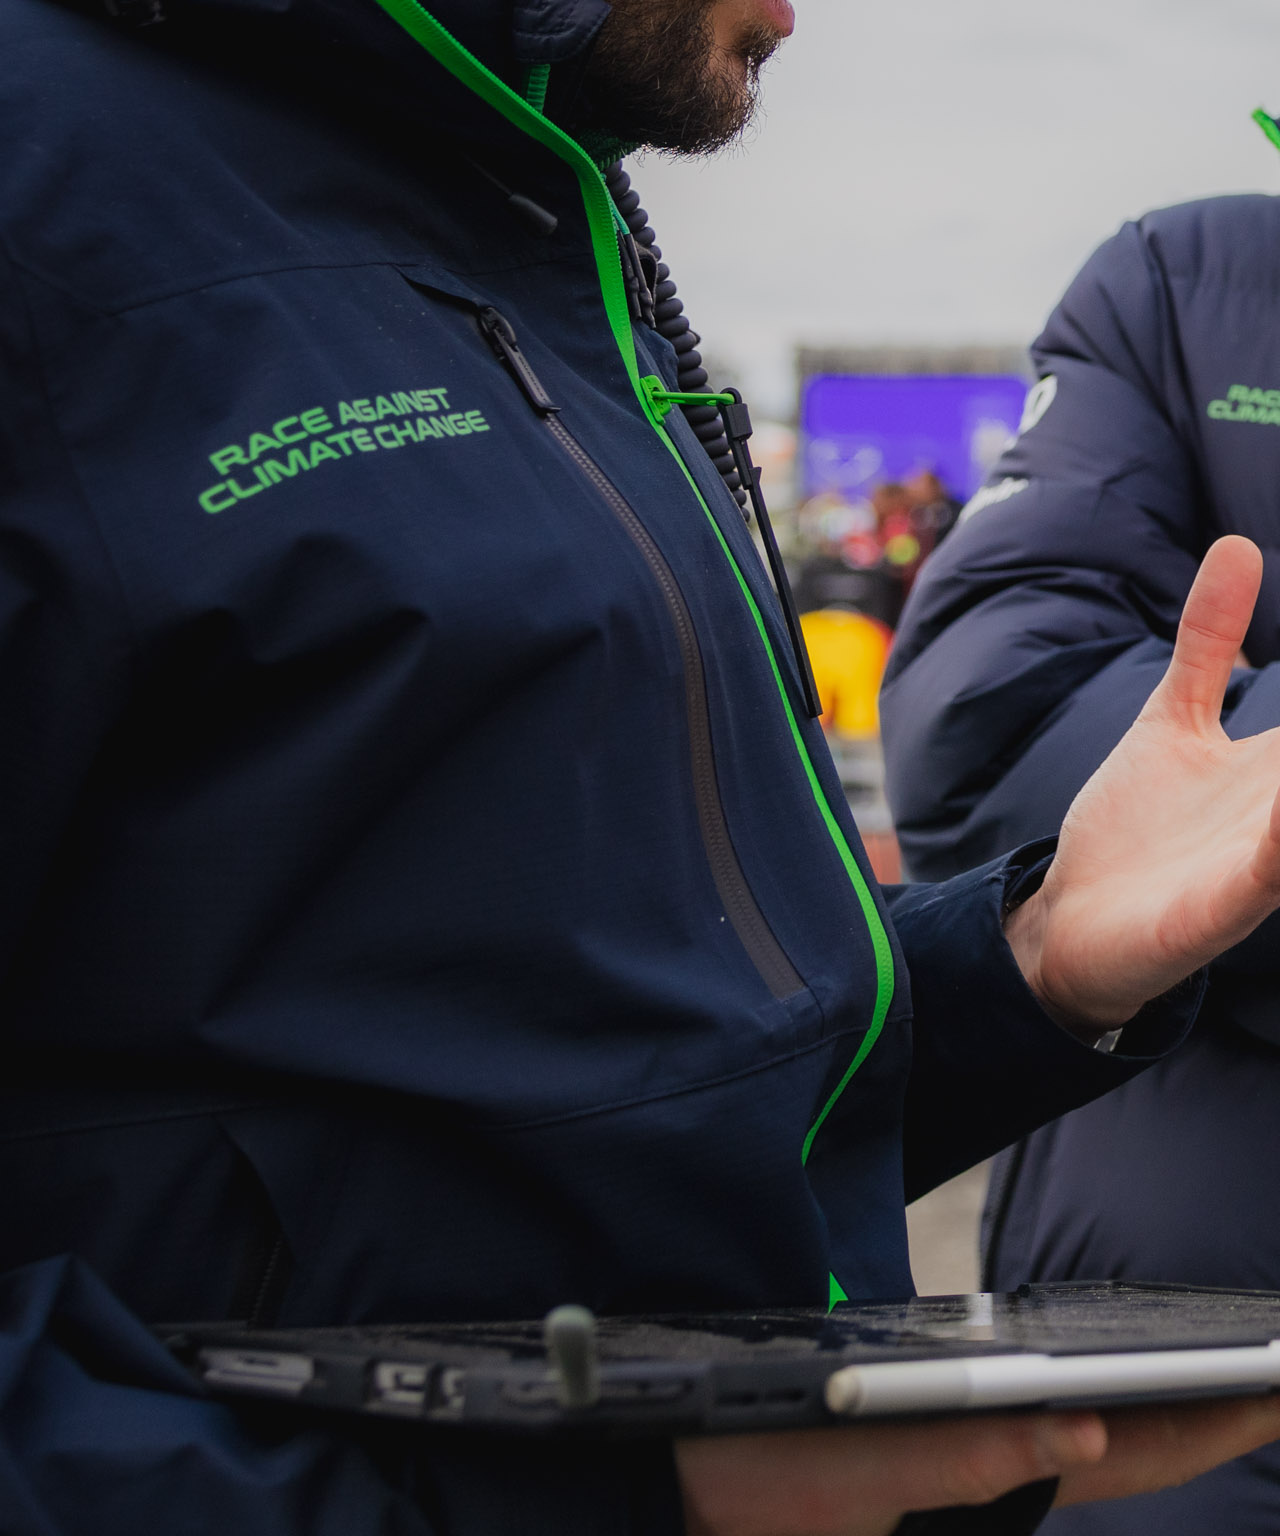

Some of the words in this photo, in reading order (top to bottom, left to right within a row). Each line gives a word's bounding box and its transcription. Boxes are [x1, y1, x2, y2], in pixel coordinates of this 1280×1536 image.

[198, 427, 378, 514] CLIMATE
[372, 409, 491, 450] CHANGE
[208, 406, 335, 476] RACE
[337, 387, 451, 426] AGAINST
